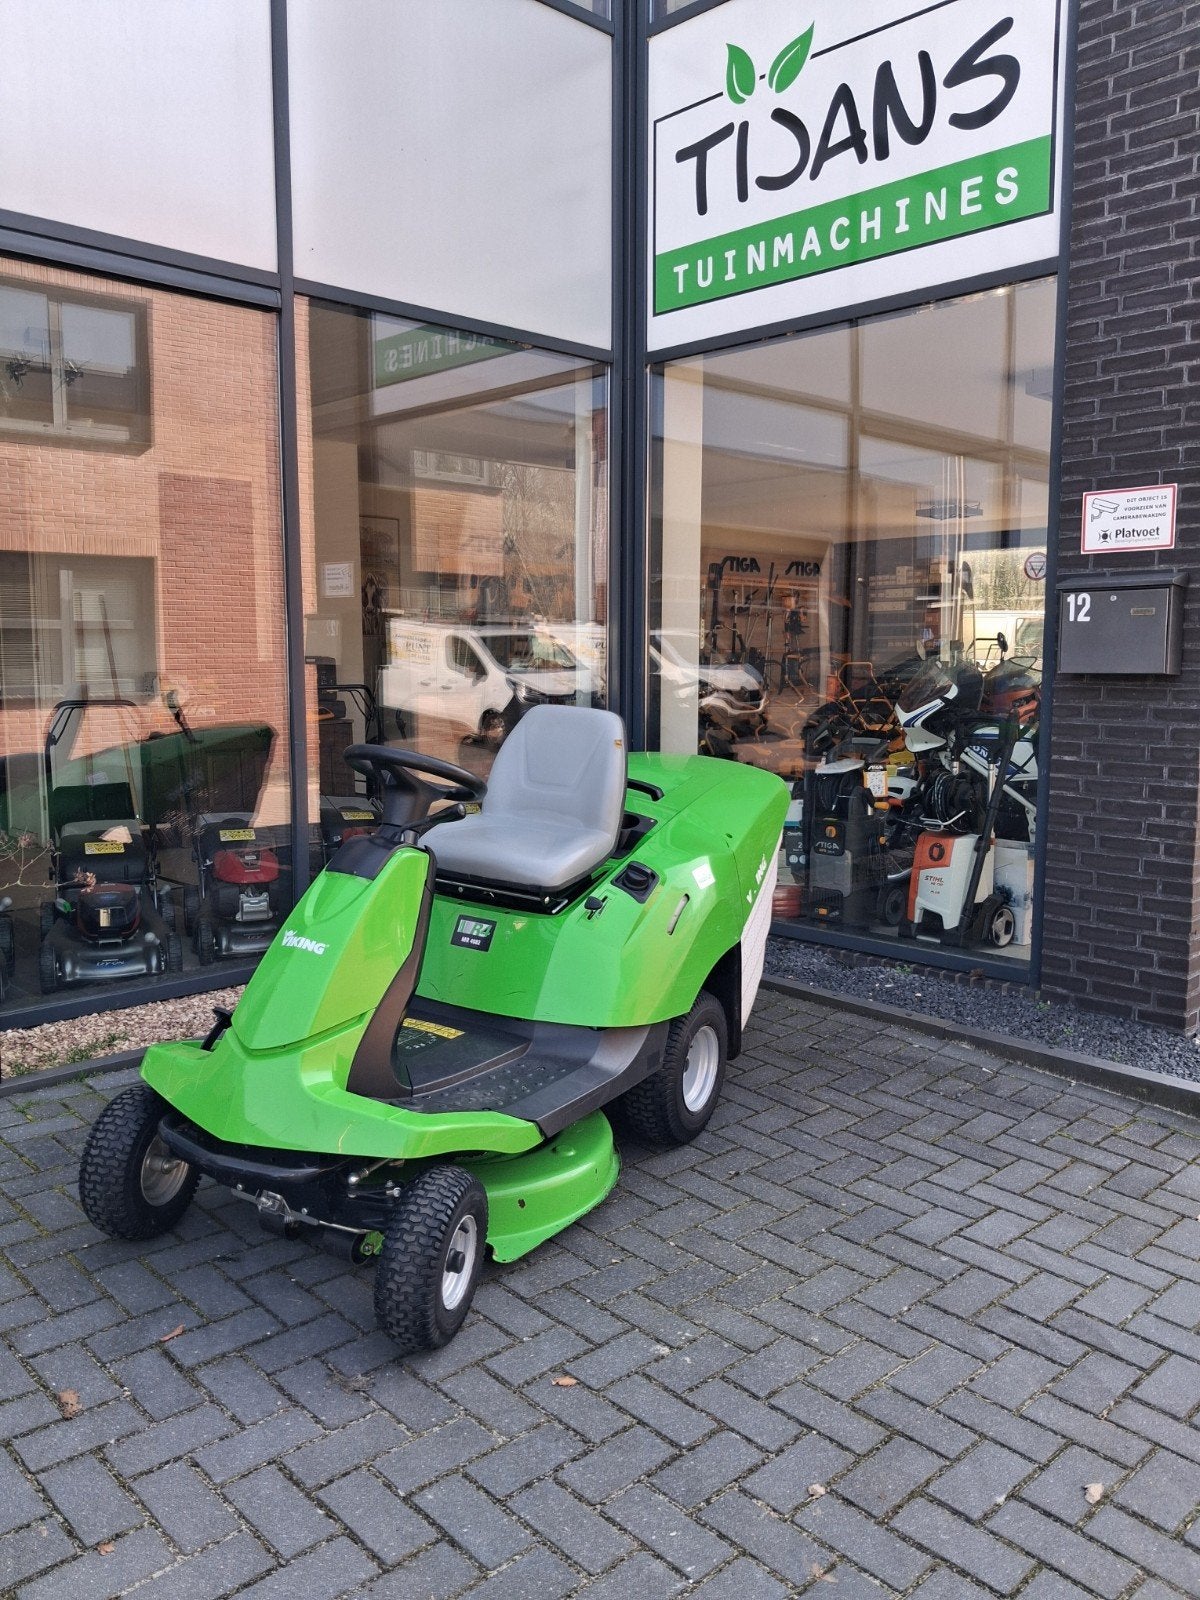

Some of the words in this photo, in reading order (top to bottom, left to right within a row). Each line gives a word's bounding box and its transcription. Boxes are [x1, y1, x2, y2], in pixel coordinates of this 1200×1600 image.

[673, 167, 1019, 294] TUINMACHINES
[1113, 512, 1167, 521] CAMERABEWAKING
[1115, 526, 1160, 538] Platvoet
[719, 555, 760, 573] STIGA
[785, 560, 820, 577] STIGA
[1067, 593, 1091, 622] 12
[815, 841, 840, 850] STIGA
[924, 875, 944, 883] STIHL
[282, 930, 327, 955] VIKING
